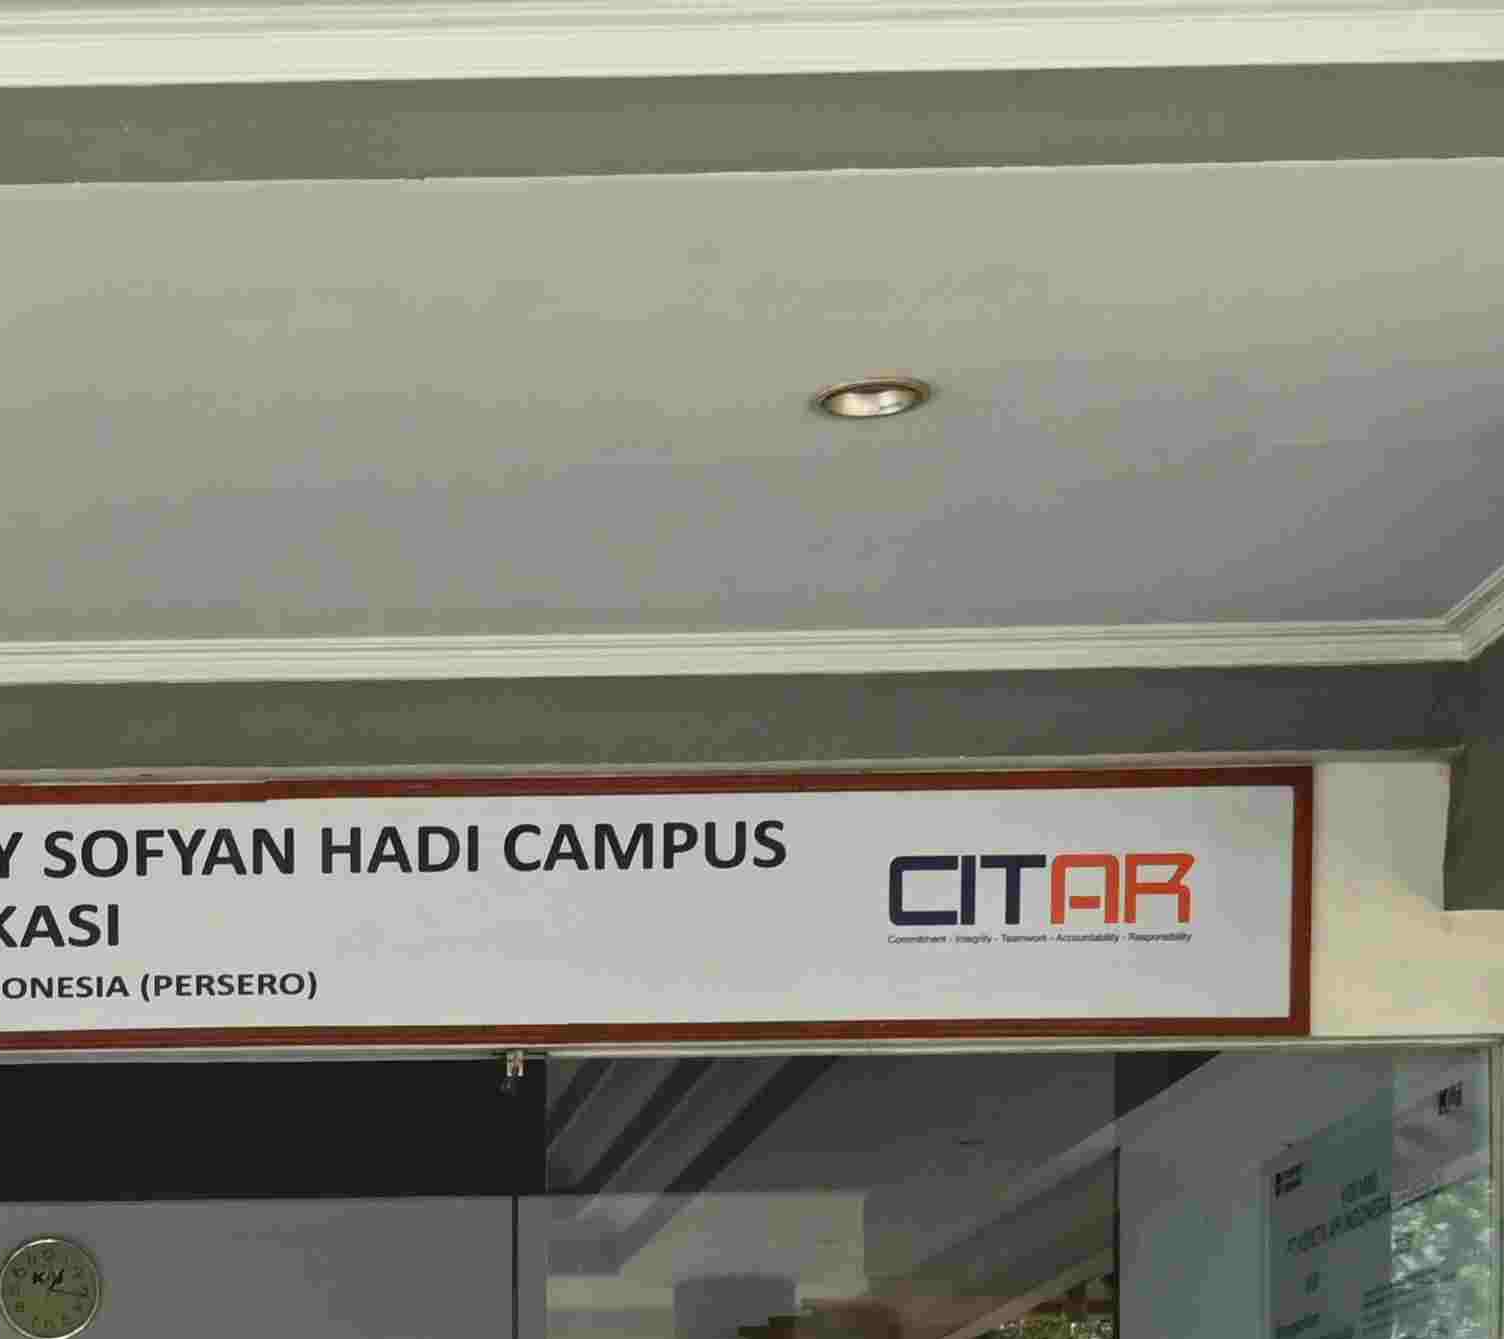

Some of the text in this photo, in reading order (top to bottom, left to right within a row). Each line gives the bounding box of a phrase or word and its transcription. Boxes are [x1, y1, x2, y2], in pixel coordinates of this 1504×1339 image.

[43, 828, 294, 879] SOFYAN
[321, 825, 479, 874] HADI
[503, 820, 787, 872] CAMPUS
[889, 853, 1196, 926] CITAR
[140, 971, 317, 1002] (PERSERO)
